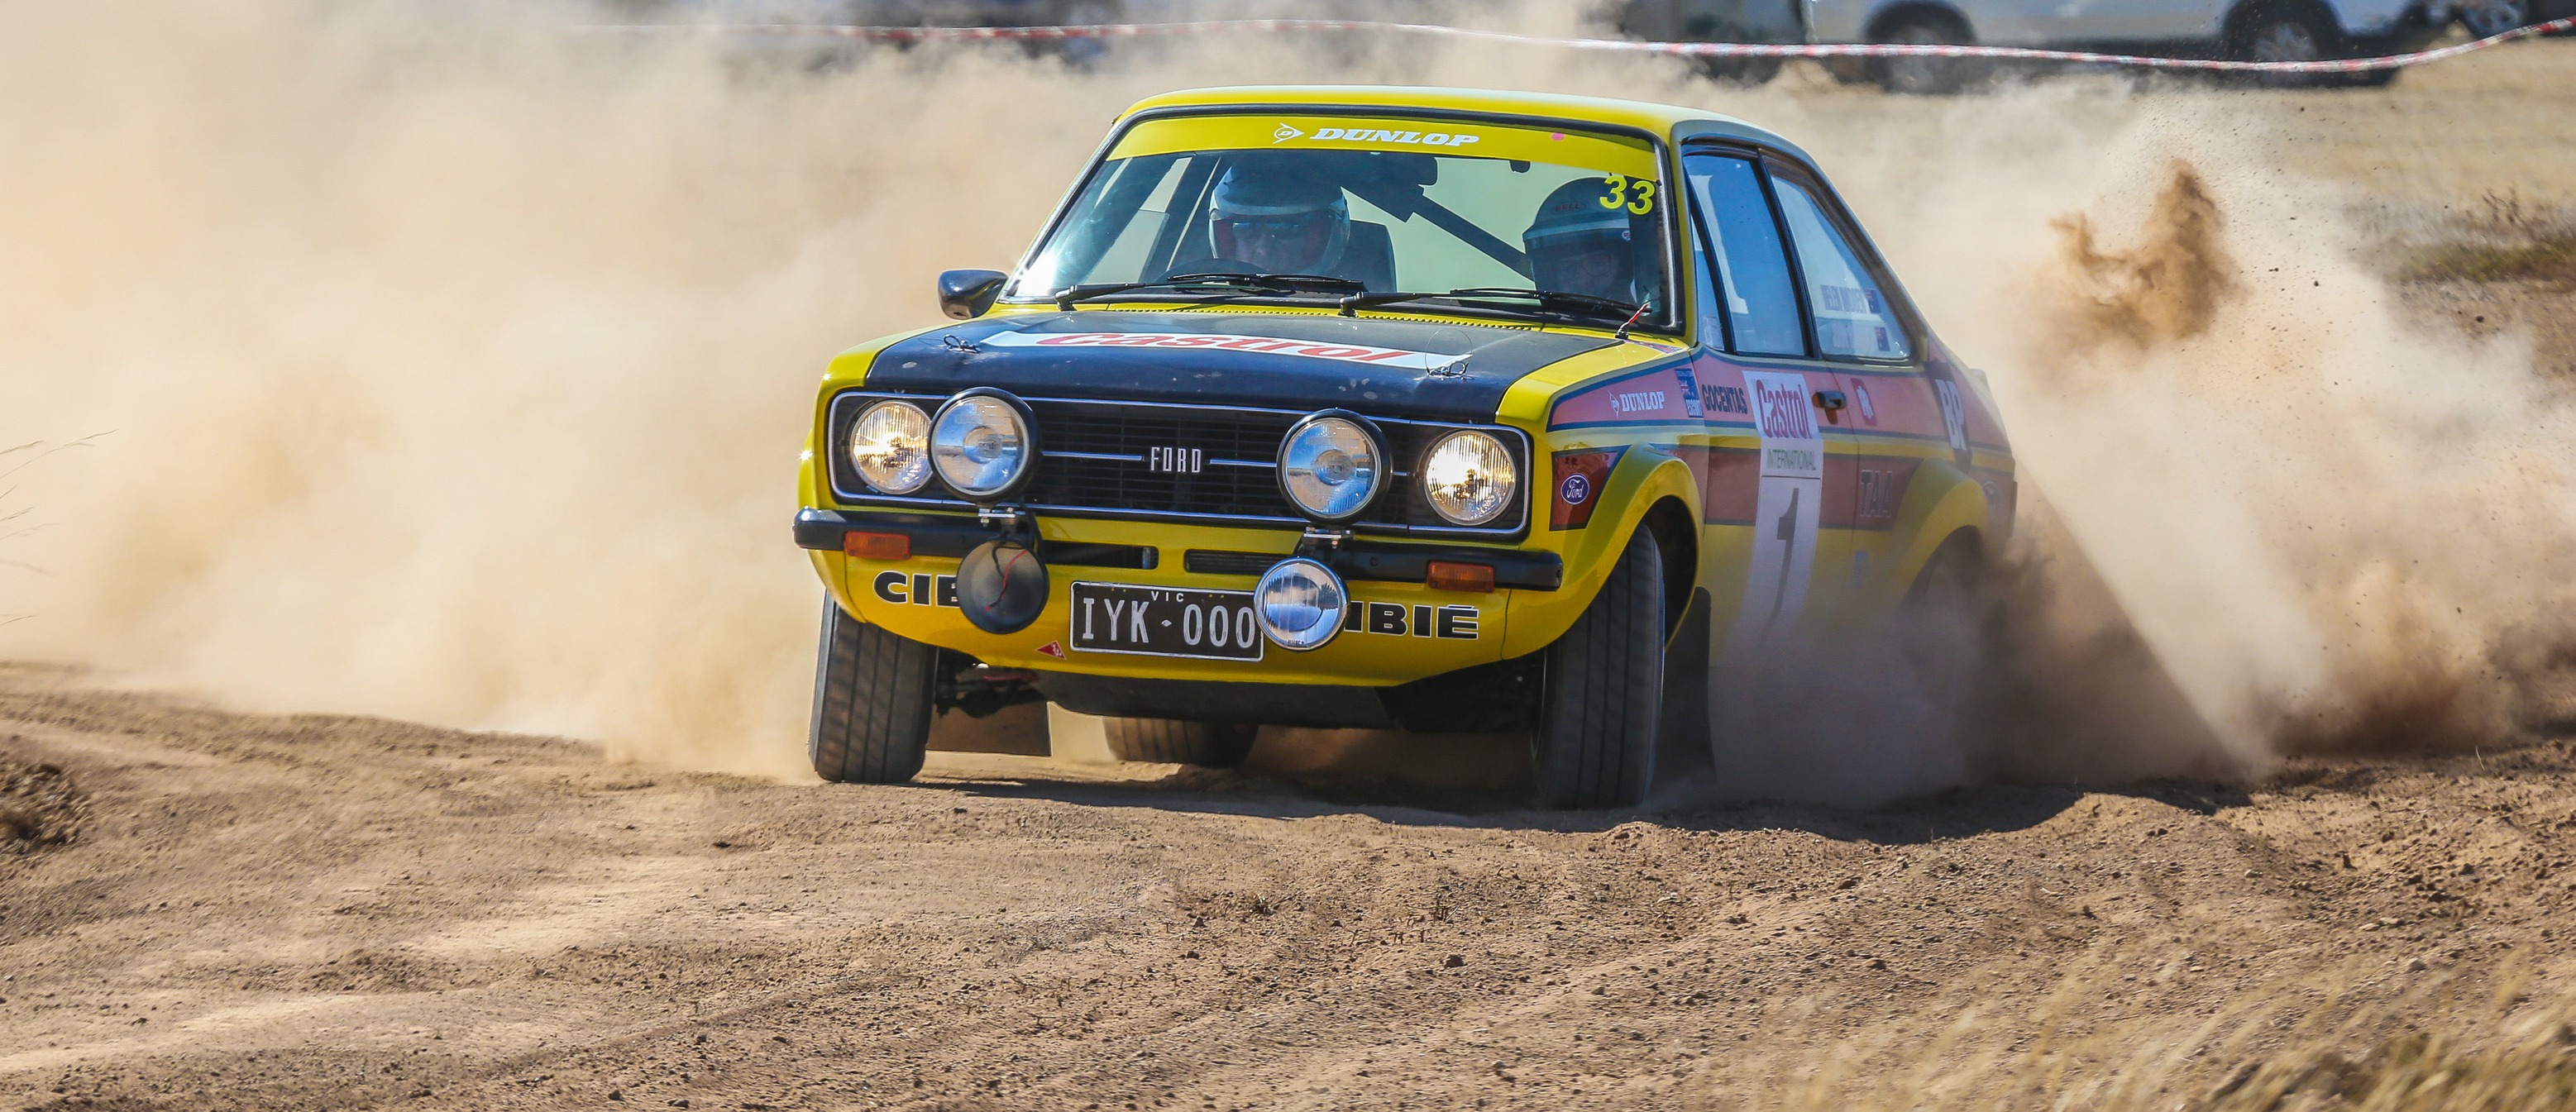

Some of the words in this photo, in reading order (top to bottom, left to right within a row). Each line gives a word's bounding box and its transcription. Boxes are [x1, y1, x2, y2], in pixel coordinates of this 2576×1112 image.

[1309, 127, 1479, 147] DUNLOP
[1599, 174, 1656, 216] 33
[1035, 332, 1415, 362] Castrol
[1619, 391, 1666, 412] DUNLOP
[1701, 384, 1748, 415] GOCENTAS
[1756, 379, 1813, 440] Castrol
[1935, 378, 1967, 451] BP
[1150, 446, 1202, 473] FORD
[1766, 448, 1817, 471] INTERNATIONAL
[1565, 478, 1584, 499] Ford
[1758, 487, 1800, 641] 1
[872, 570, 960, 608] CIB
[1150, 590, 1185, 604] VIC
[1081, 597, 1150, 643] IYK
